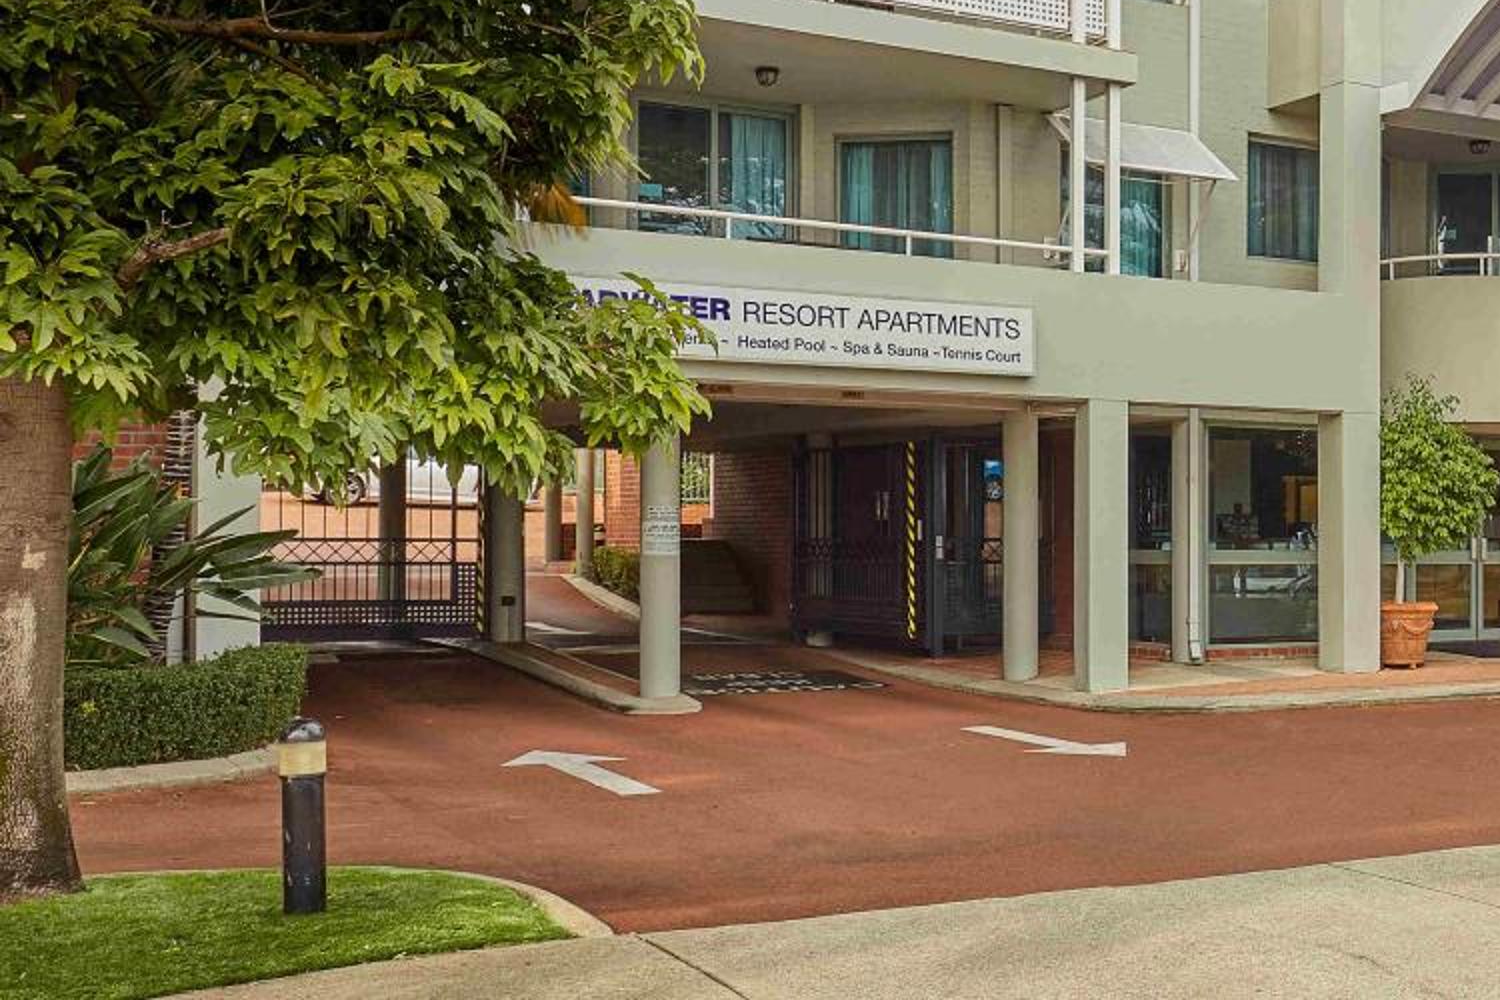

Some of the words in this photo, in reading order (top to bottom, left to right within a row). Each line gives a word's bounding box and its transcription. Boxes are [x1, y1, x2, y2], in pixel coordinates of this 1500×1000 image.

[742, 301, 850, 329] RESORT
[857, 309, 1021, 340] APARTMENTS
[737, 335, 790, 350] Heated
[794, 337, 825, 352] Pool
[843, 341, 870, 356] Spa
[873, 342, 882, 355] &
[887, 343, 929, 358] Sauna
[941, 347, 982, 361] Tennis
[985, 349, 1021, 363] Court
